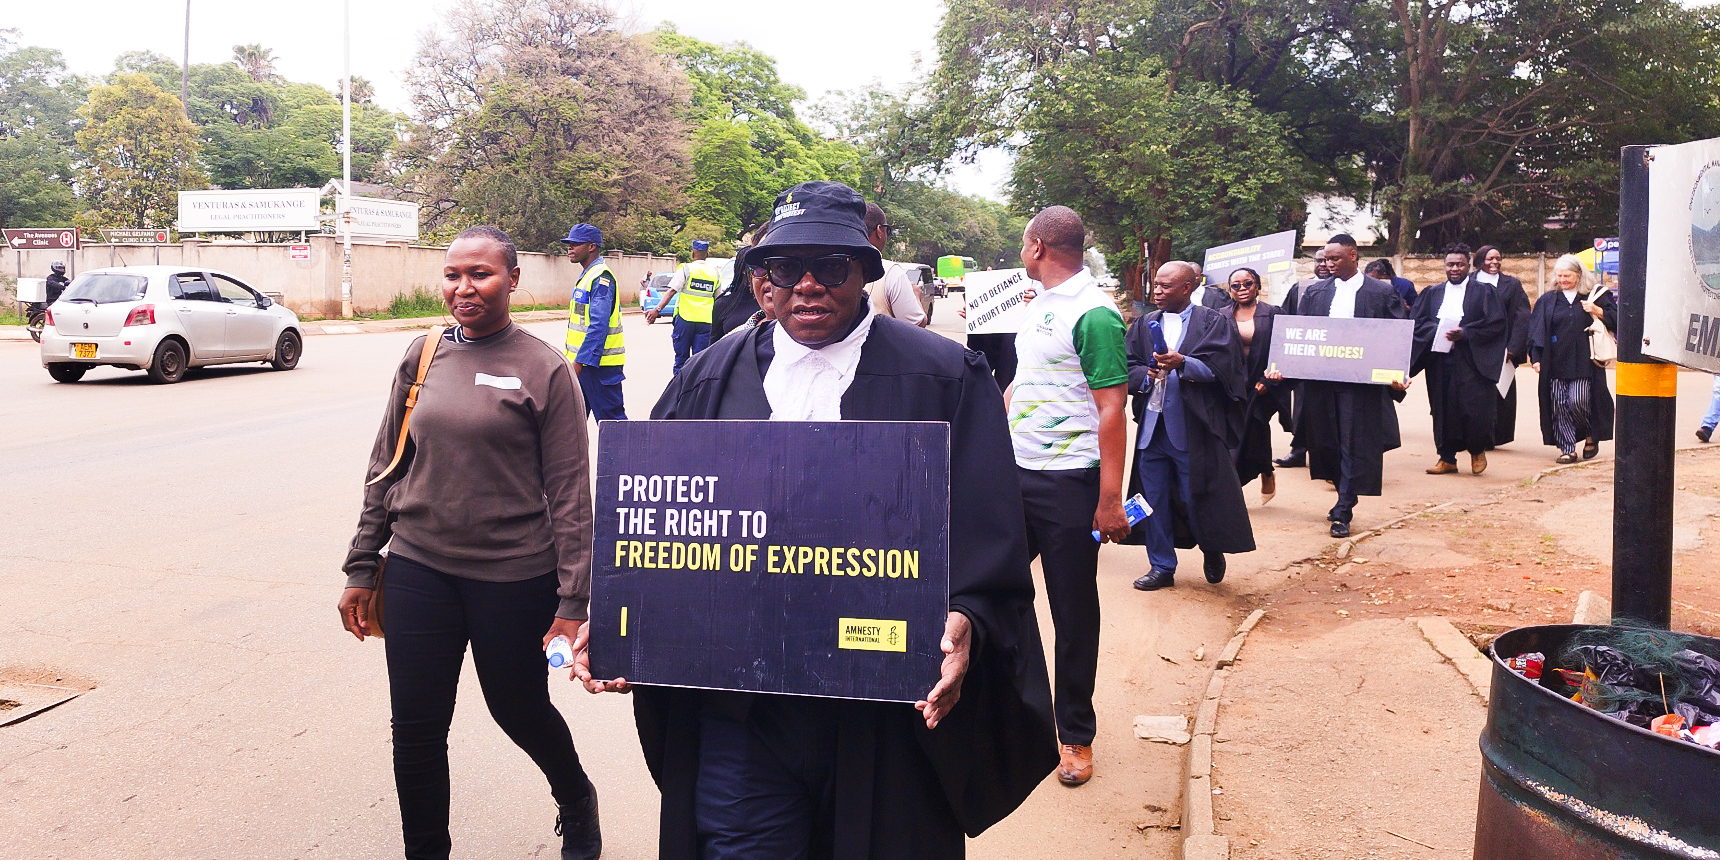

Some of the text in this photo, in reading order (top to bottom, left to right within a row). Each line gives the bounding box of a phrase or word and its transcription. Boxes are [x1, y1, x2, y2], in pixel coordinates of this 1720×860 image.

[192, 200, 305, 209] VENTURAS & SAMUKANGE
[349, 206, 374, 216] ENTURAS
[381, 209, 413, 219] SAMUKANGE
[1206, 249, 1285, 272] STARTS WITH THE STATE!
[1207, 244, 1262, 262] ACCOUNTABILITY
[690, 281, 713, 292] POLICE
[968, 271, 1023, 310] NO TO DEFIANCE
[968, 320, 977, 332] OF
[976, 305, 1001, 326] COURT
[1285, 327, 1328, 341] WE ARE
[1685, 313, 1720, 358] EM
[1283, 342, 1364, 360] THEIR VOICES!
[617, 474, 719, 503] PROTECT
[616, 507, 767, 539] THE RIGHT TO
[614, 540, 920, 579] FREEDOM OF EXPRESSION
[844, 635, 881, 644] INTERNATIONAL
[845, 625, 881, 636] AMNESTY
